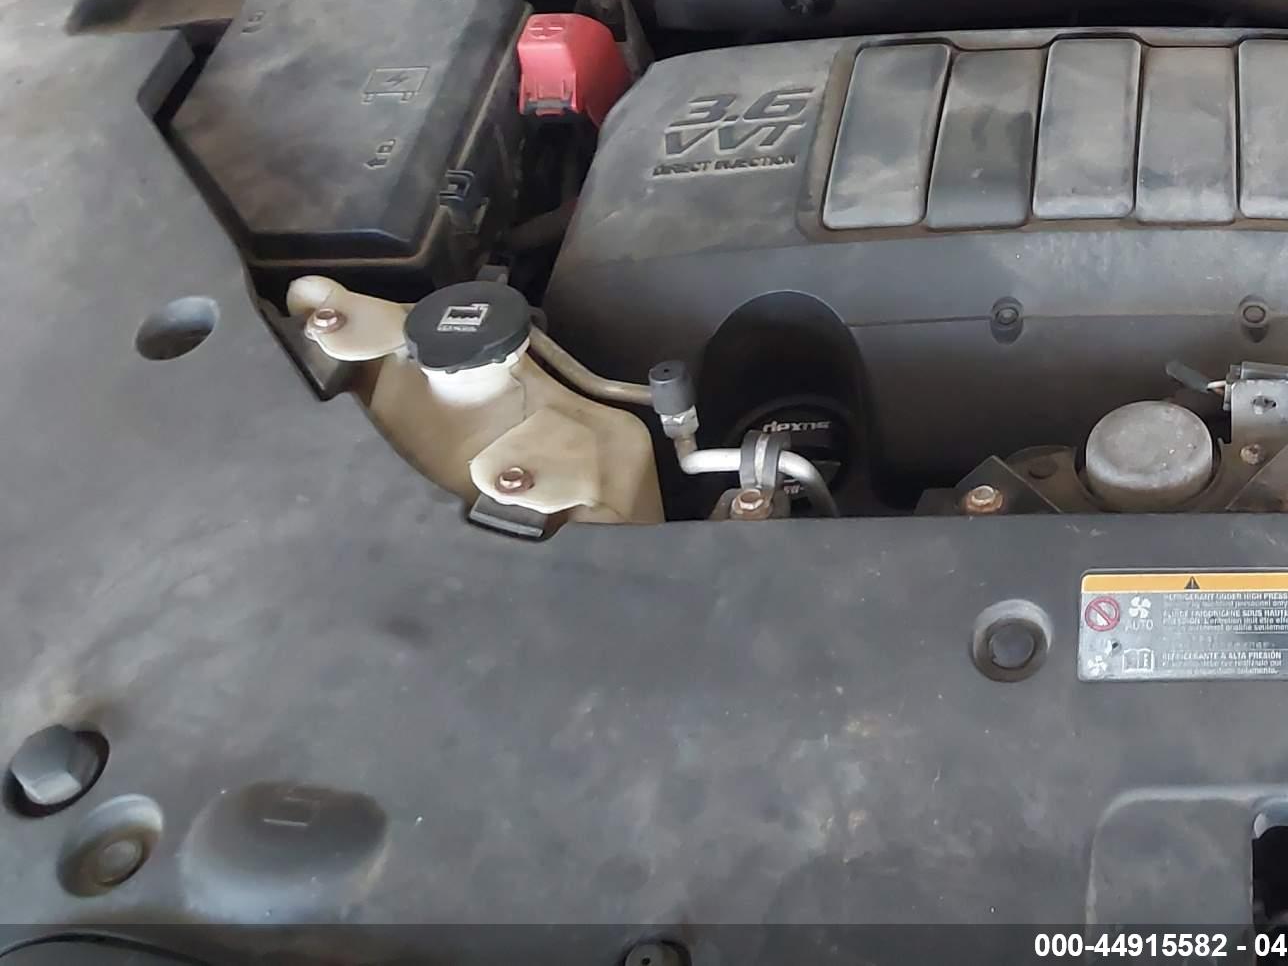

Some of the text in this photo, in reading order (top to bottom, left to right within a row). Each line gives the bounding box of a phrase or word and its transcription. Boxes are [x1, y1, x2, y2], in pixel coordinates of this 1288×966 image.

[669, 87, 816, 126] 3.6
[664, 120, 807, 157] VVT
[652, 154, 797, 178] DIRECT INJECTION
[1242, 609, 1263, 617] SOUS
[1264, 609, 1288, 617] HAUTE
[1125, 619, 1153, 632] AUTO
[1228, 651, 1247, 659] ALTA
